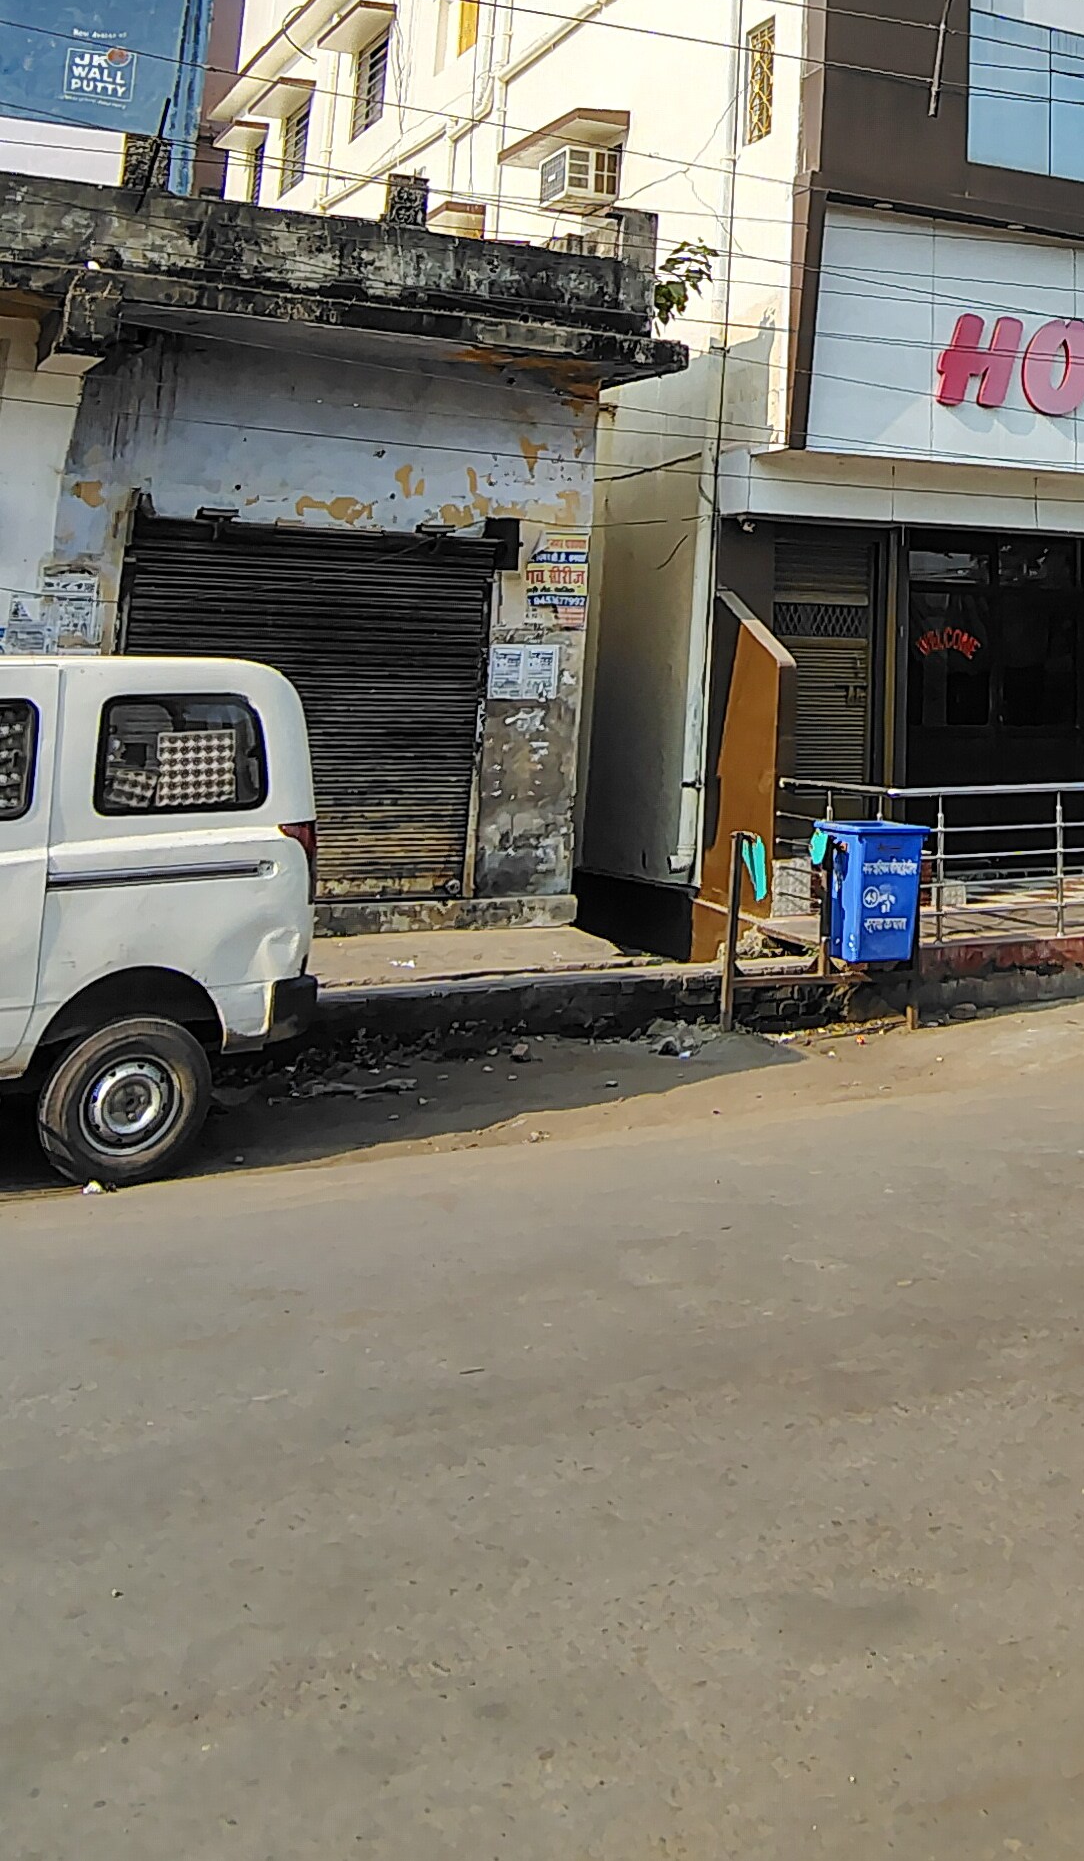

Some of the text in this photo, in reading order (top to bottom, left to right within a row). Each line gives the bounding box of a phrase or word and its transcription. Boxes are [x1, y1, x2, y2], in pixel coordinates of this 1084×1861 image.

[74, 53, 108, 68] JK
[72, 66, 125, 84] WALL
[71, 78, 126, 97] PUTTY
[915, 626, 981, 660] WELCOME
